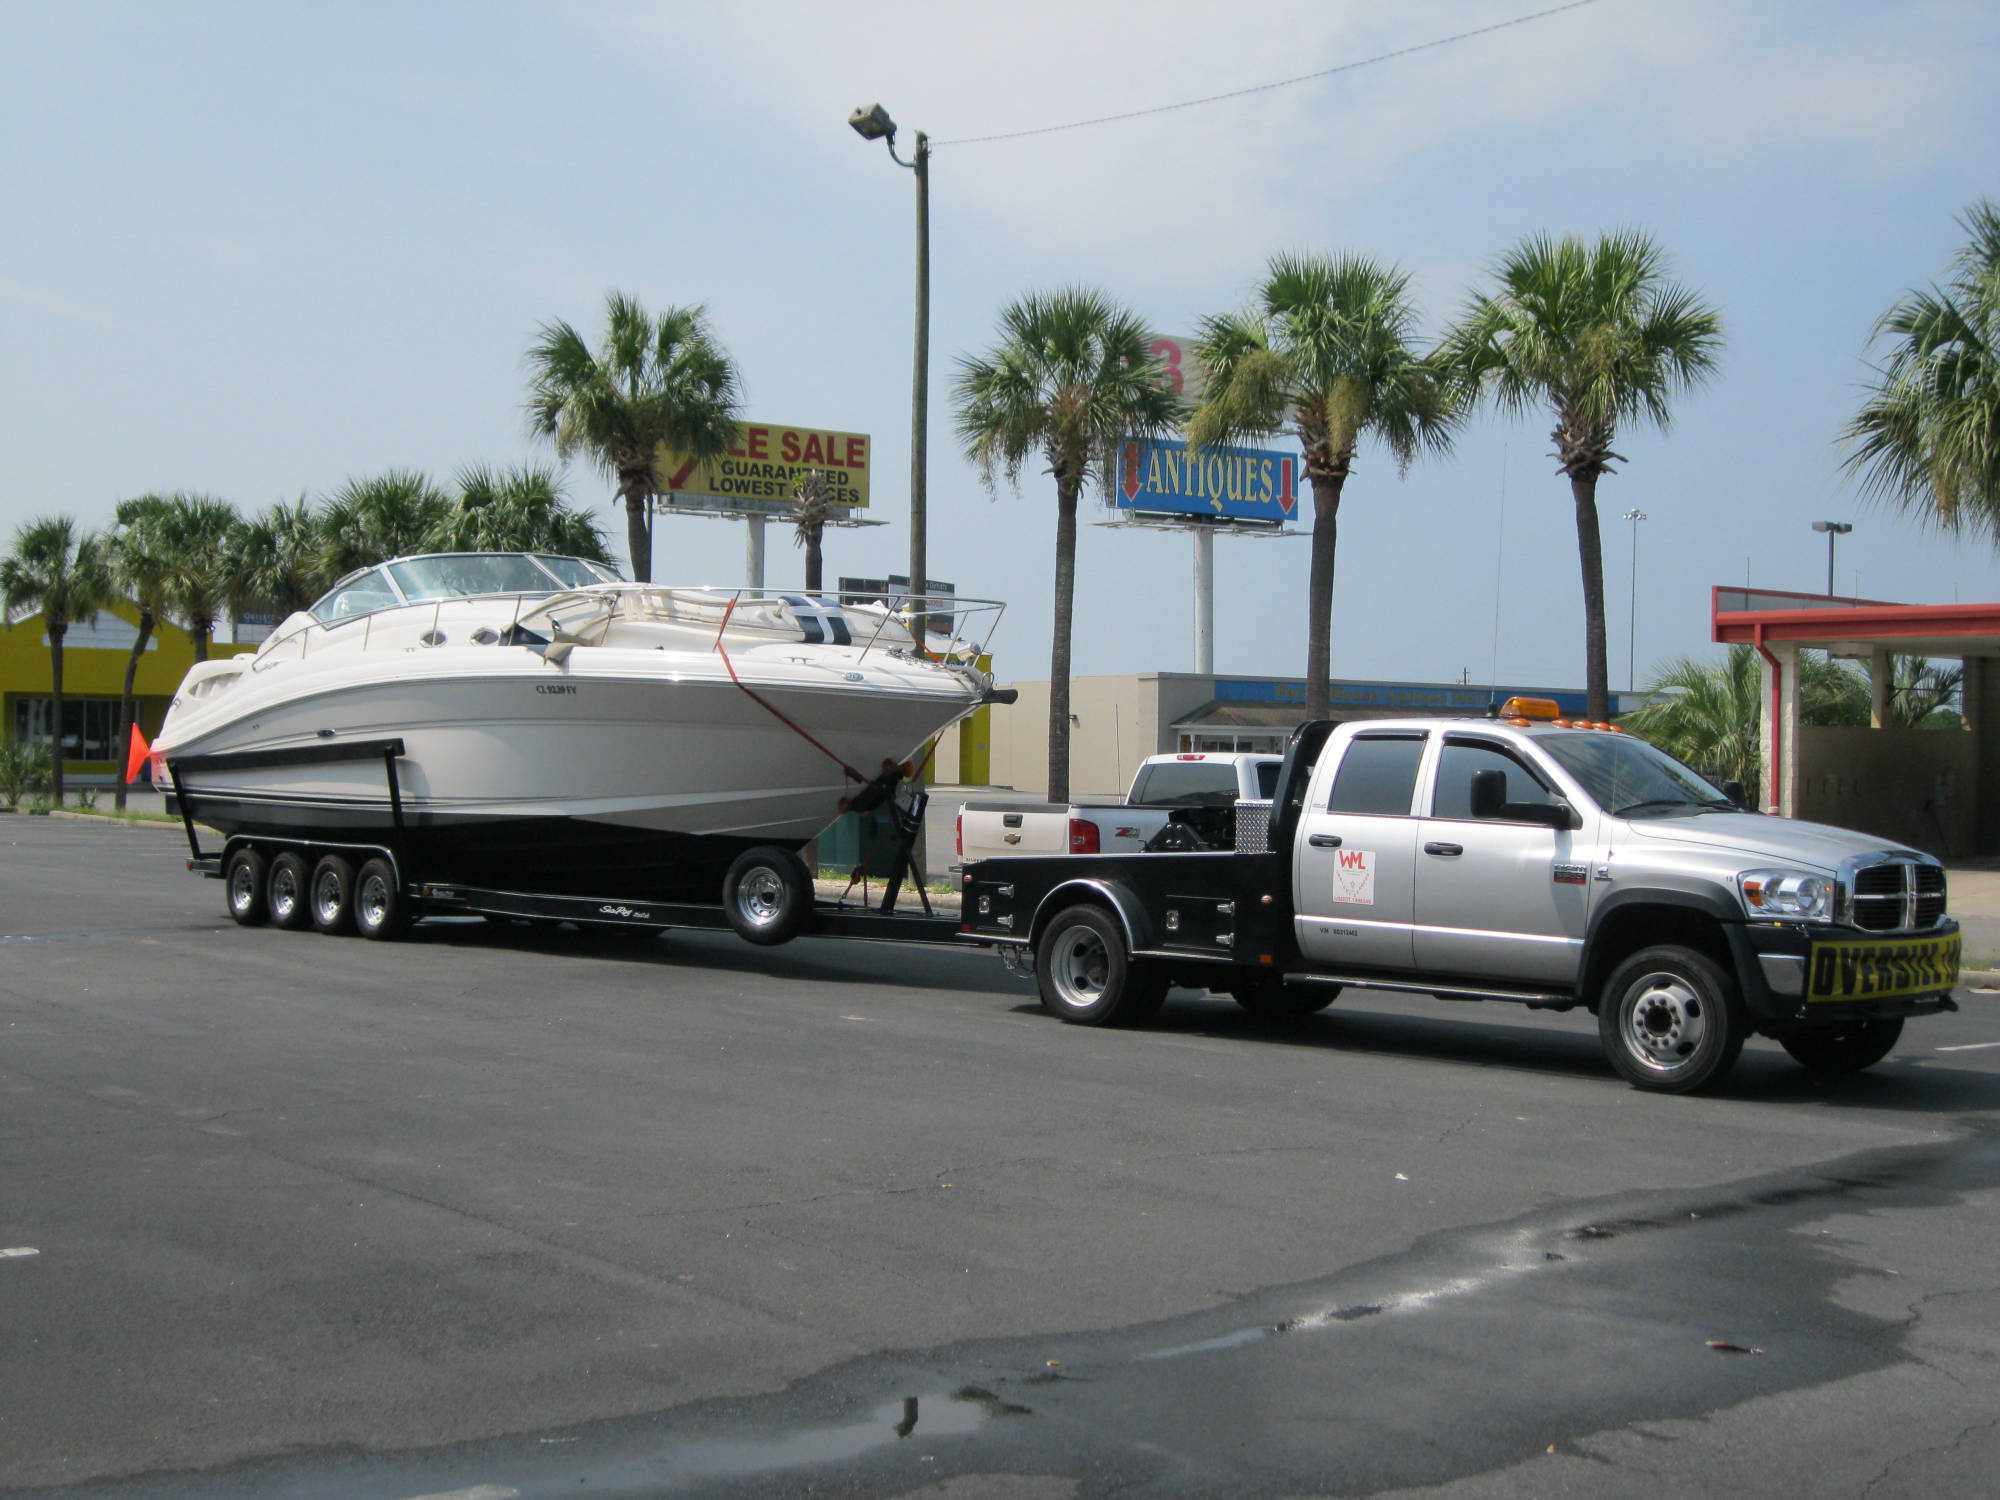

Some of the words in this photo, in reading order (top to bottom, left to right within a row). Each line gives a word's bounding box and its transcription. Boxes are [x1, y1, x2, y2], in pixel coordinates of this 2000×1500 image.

[781, 430, 865, 468] SALE
[721, 460, 849, 485] GUARANED
[1146, 447, 1274, 512] ANTIQUES
[709, 477, 787, 497] LOWEST
[1276, 684, 1306, 699] Far
[1339, 850, 1366, 869] WML
[1812, 943, 1942, 996] OVERSIZE
